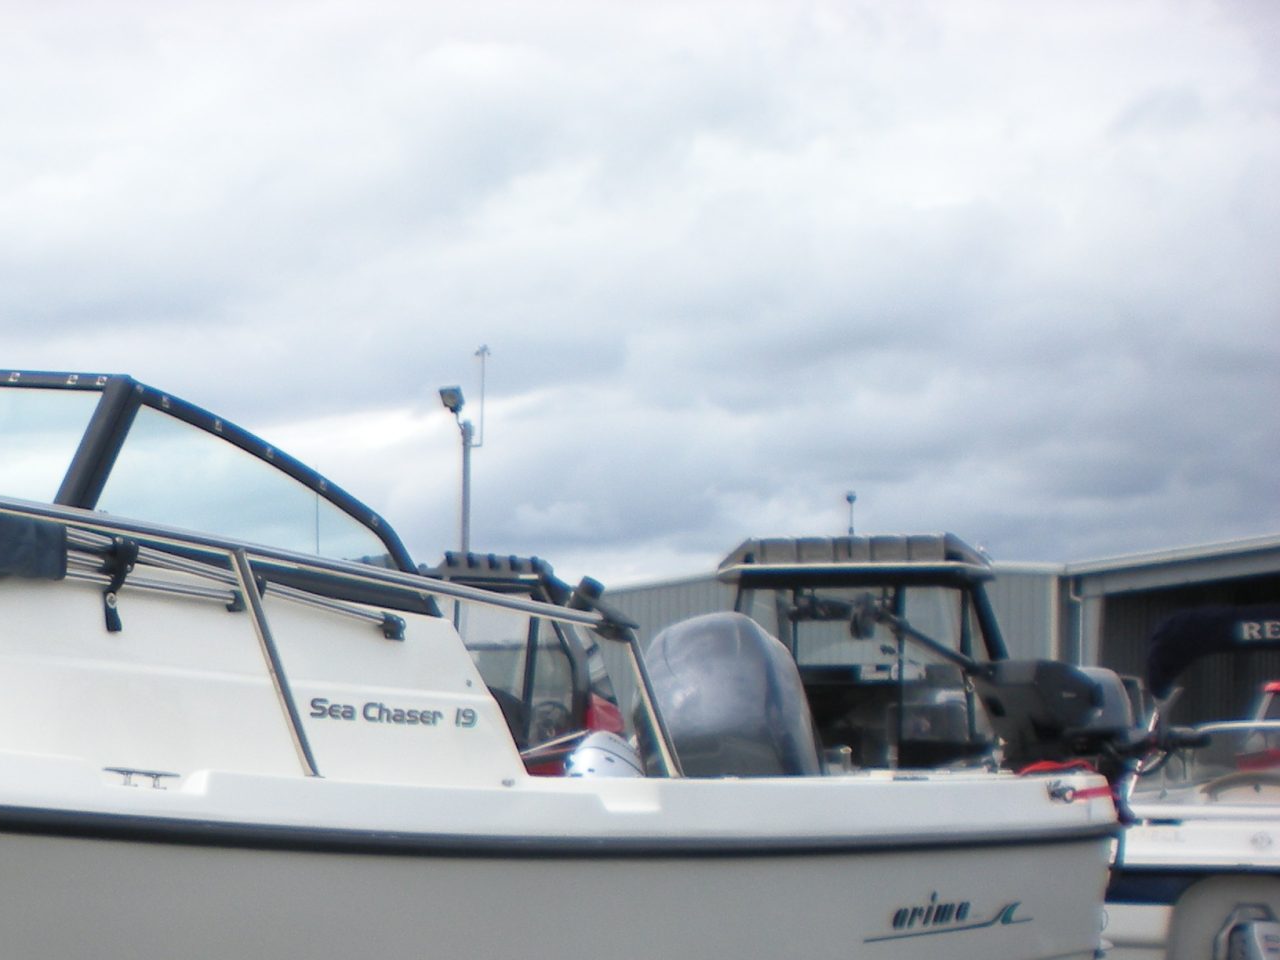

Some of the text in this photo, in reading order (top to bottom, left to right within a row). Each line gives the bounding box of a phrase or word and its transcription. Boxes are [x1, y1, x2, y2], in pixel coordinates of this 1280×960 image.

[310, 697, 477, 728] Sea Chaser 19
